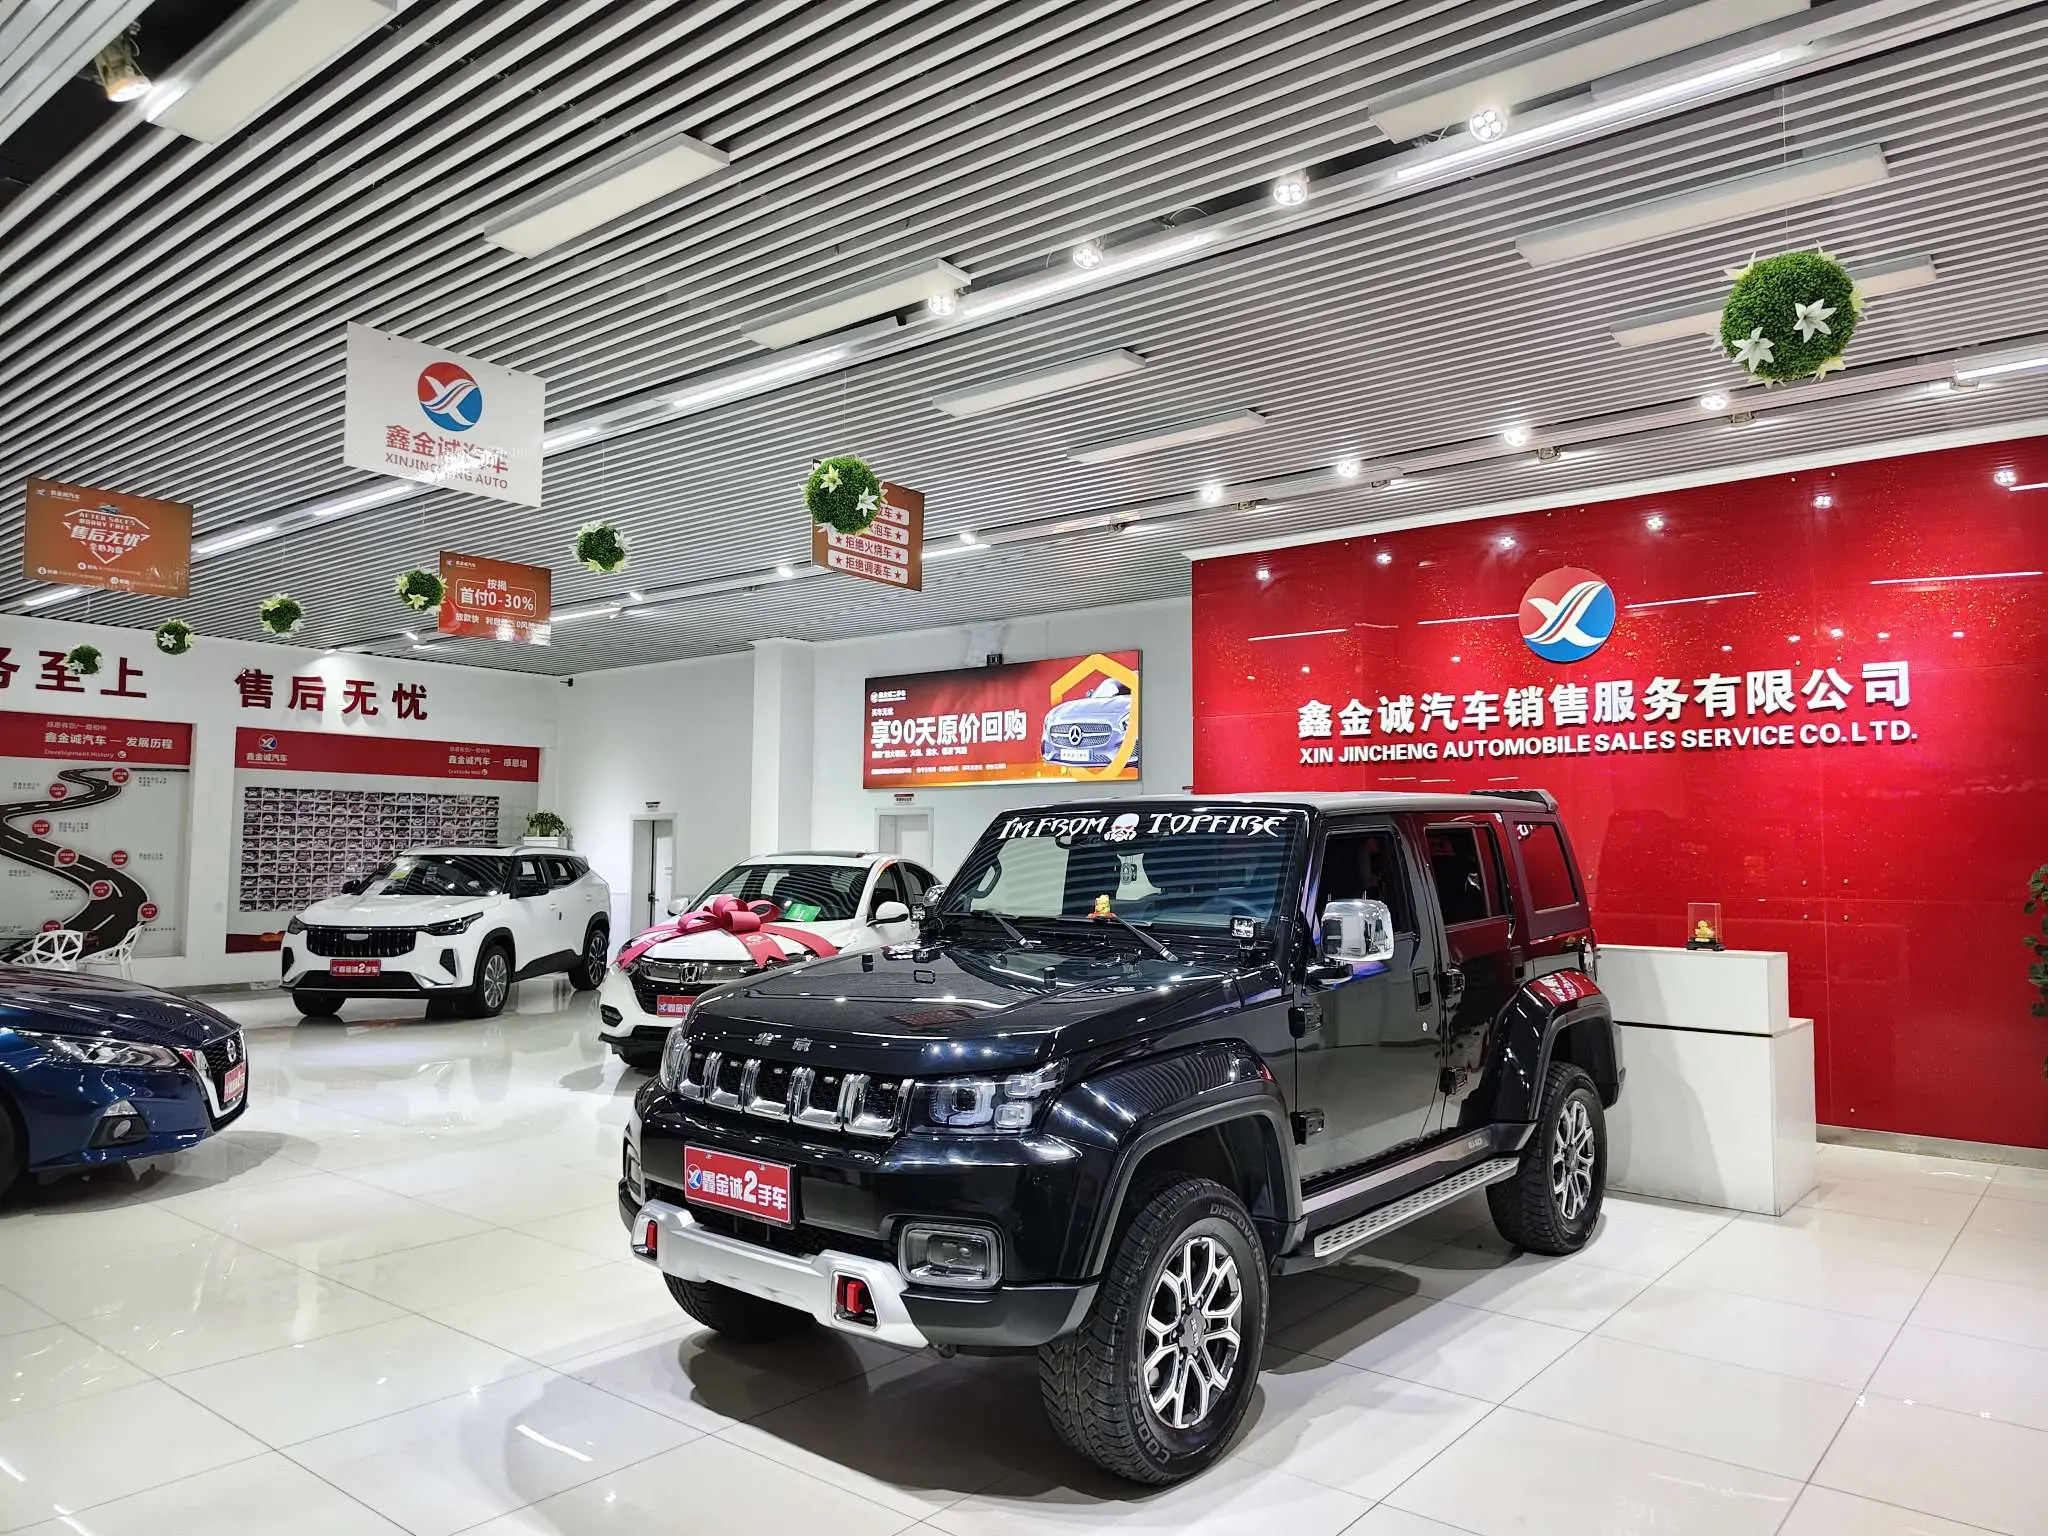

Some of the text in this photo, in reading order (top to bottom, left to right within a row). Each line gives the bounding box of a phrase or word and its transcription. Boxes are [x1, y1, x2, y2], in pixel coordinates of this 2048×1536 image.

[476, 474, 508, 489] AUTO
[70, 525, 140, 548] 售后无忧
[846, 535, 892, 558] 拒绝火烧车
[846, 556, 892, 578] 拒绝调表车
[487, 578, 507, 591] 按揭
[460, 586, 534, 611] 首付0-30%
[234, 668, 428, 720] 售后无忧
[1298, 660, 1910, 738] 鑫金诚汽车销售服务有限公司
[870, 709, 1027, 748] 享90天原价回购
[1300, 747, 1333, 764] XIN
[1338, 742, 1438, 762] JINCHENG
[1443, 734, 1591, 759] AUTOMOBILE
[1594, 730, 1676, 752] SALES
[1680, 725, 1794, 749] SERVICE
[1150, 812, 1288, 838] TOPFIRE
[702, 1170, 786, 1210] 鑫金诚2手车
[1128, 1361, 1170, 1464] COOPER
